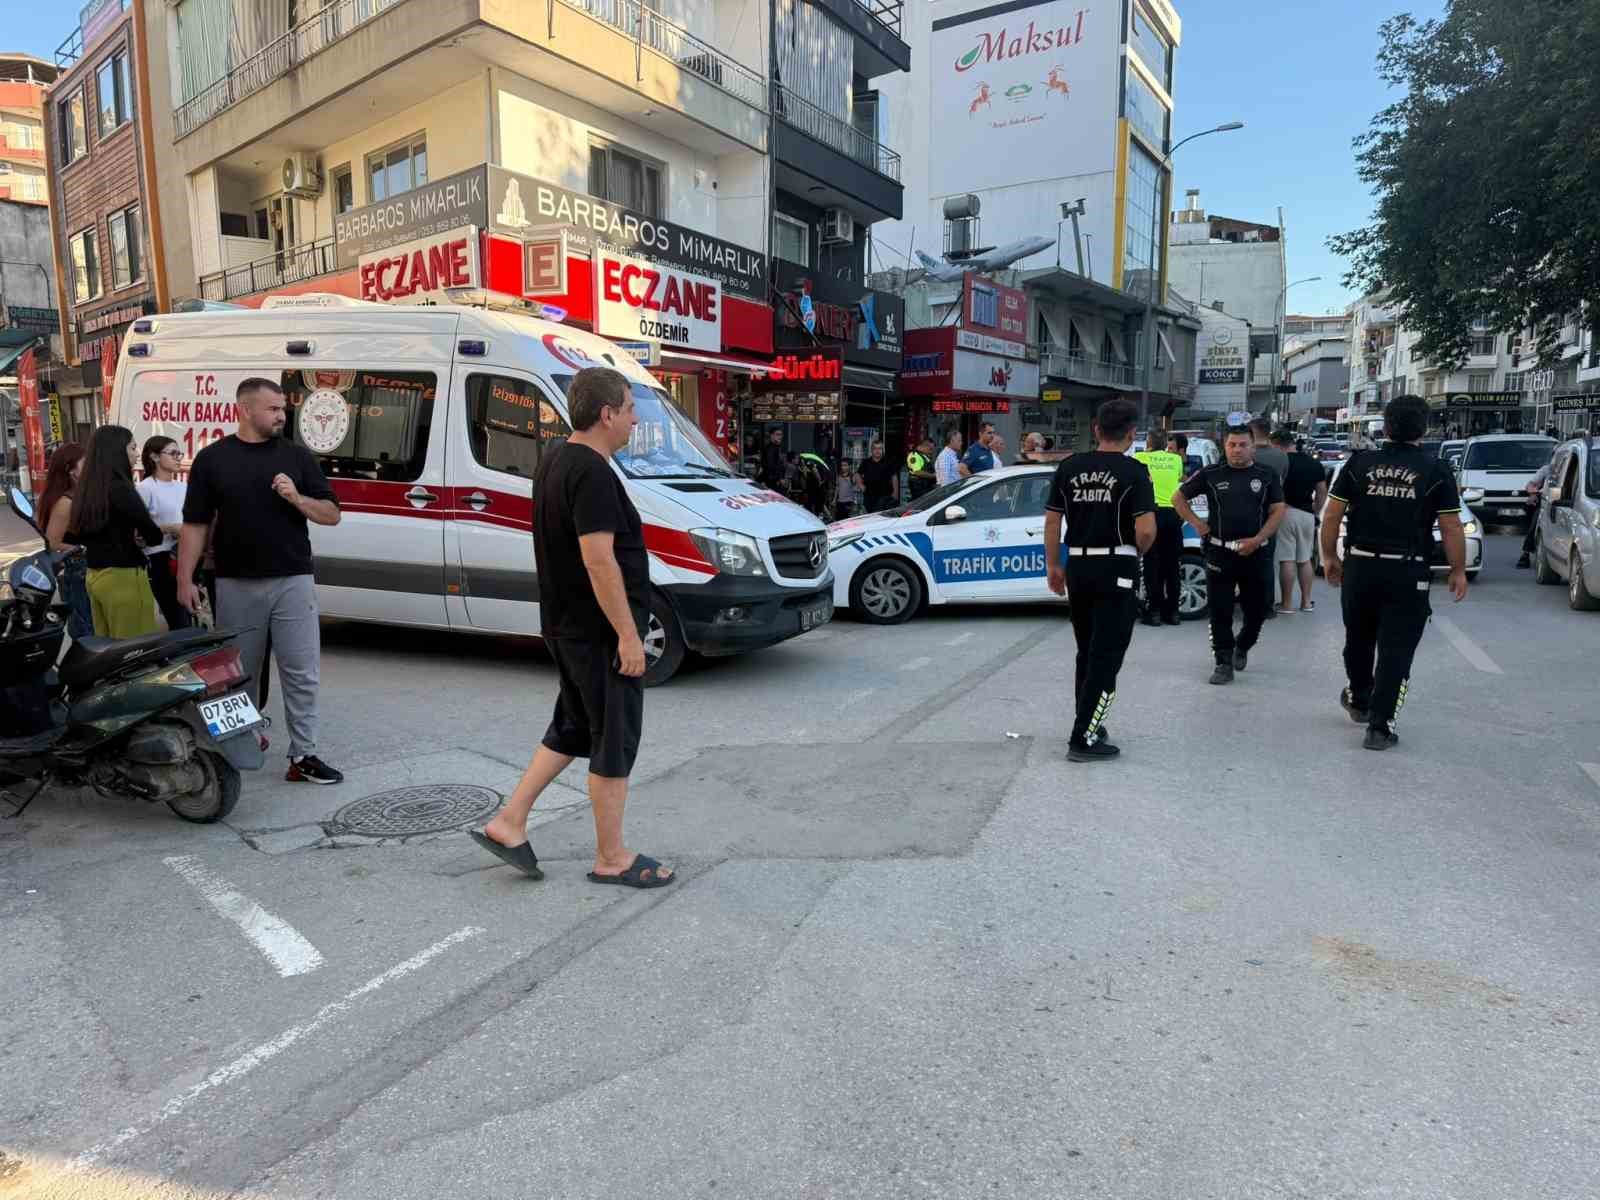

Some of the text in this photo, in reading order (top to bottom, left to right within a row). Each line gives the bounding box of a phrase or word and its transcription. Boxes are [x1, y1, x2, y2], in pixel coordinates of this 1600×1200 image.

[976, 10, 1084, 63] Maksul
[337, 202, 405, 244] BARBAROS
[538, 187, 670, 250] BARBAROS
[360, 238, 471, 302] ECZANE
[529, 246, 555, 289] E
[603, 258, 717, 323] ECZANE
[640, 314, 689, 343] ÖZDEMİR
[195, 375, 218, 396] T.C.
[143, 397, 191, 422] SAĞLIK
[1070, 470, 1118, 489] TRAFİK
[1366, 468, 1416, 484] TRAFİK
[1072, 489, 1112, 504] ZABITA
[1366, 484, 1416, 499] ZABITA
[943, 551, 1045, 575] TRAFİK POLİS
[203, 694, 249, 720] 07 BRV
[220, 713, 246, 730] 104
